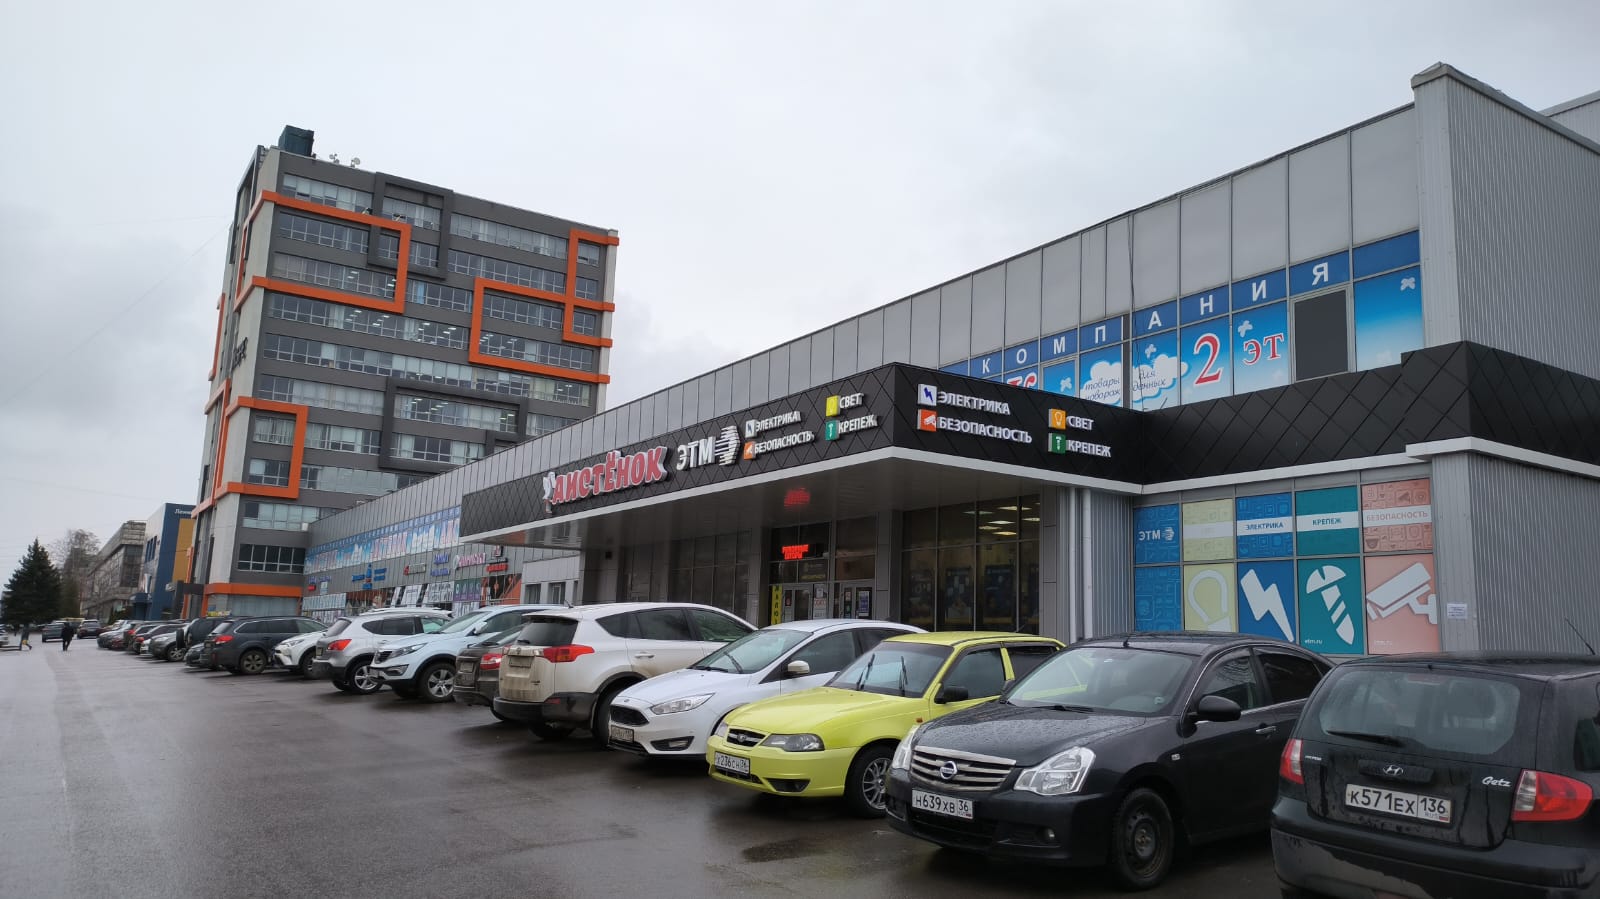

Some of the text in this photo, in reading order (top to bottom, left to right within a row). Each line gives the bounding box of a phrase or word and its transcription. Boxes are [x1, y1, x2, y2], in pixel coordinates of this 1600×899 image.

[1194, 333, 1224, 386] 2
[1085, 377, 1120, 391] товары
[839, 393, 864, 408] СВЕТ
[937, 391, 1010, 416] ЭЛЕКТРИКА
[755, 411, 801, 432] ЭЛЕКТРИКА
[838, 414, 878, 433] КРЕПЕЖ
[938, 416, 1032, 444] БЕЗОПАСНОСТЬ
[1066, 415, 1094, 431] СВЕТ
[754, 431, 814, 454] БЕЗОПАСНОСТЬ
[1066, 439, 1111, 458] КРЕПЕЖ
[676, 436, 716, 471] ЭТМ
[552, 446, 668, 505] АИСТЁНОК
[1312, 517, 1342, 527] КРЕПЕЖ
[1366, 511, 1428, 522] БЕЗОПАСНОСТЬ
[1138, 530, 1161, 541] ЭТМ
[1245, 522, 1284, 531] ЭЛЕКТРИКА
[1305, 638, 1323, 646] etm.ru
[1482, 776, 1512, 787] Getz
[915, 794, 969, 814] Н639ХВ 36
[1351, 789, 1446, 814] К571ЕХ 136
